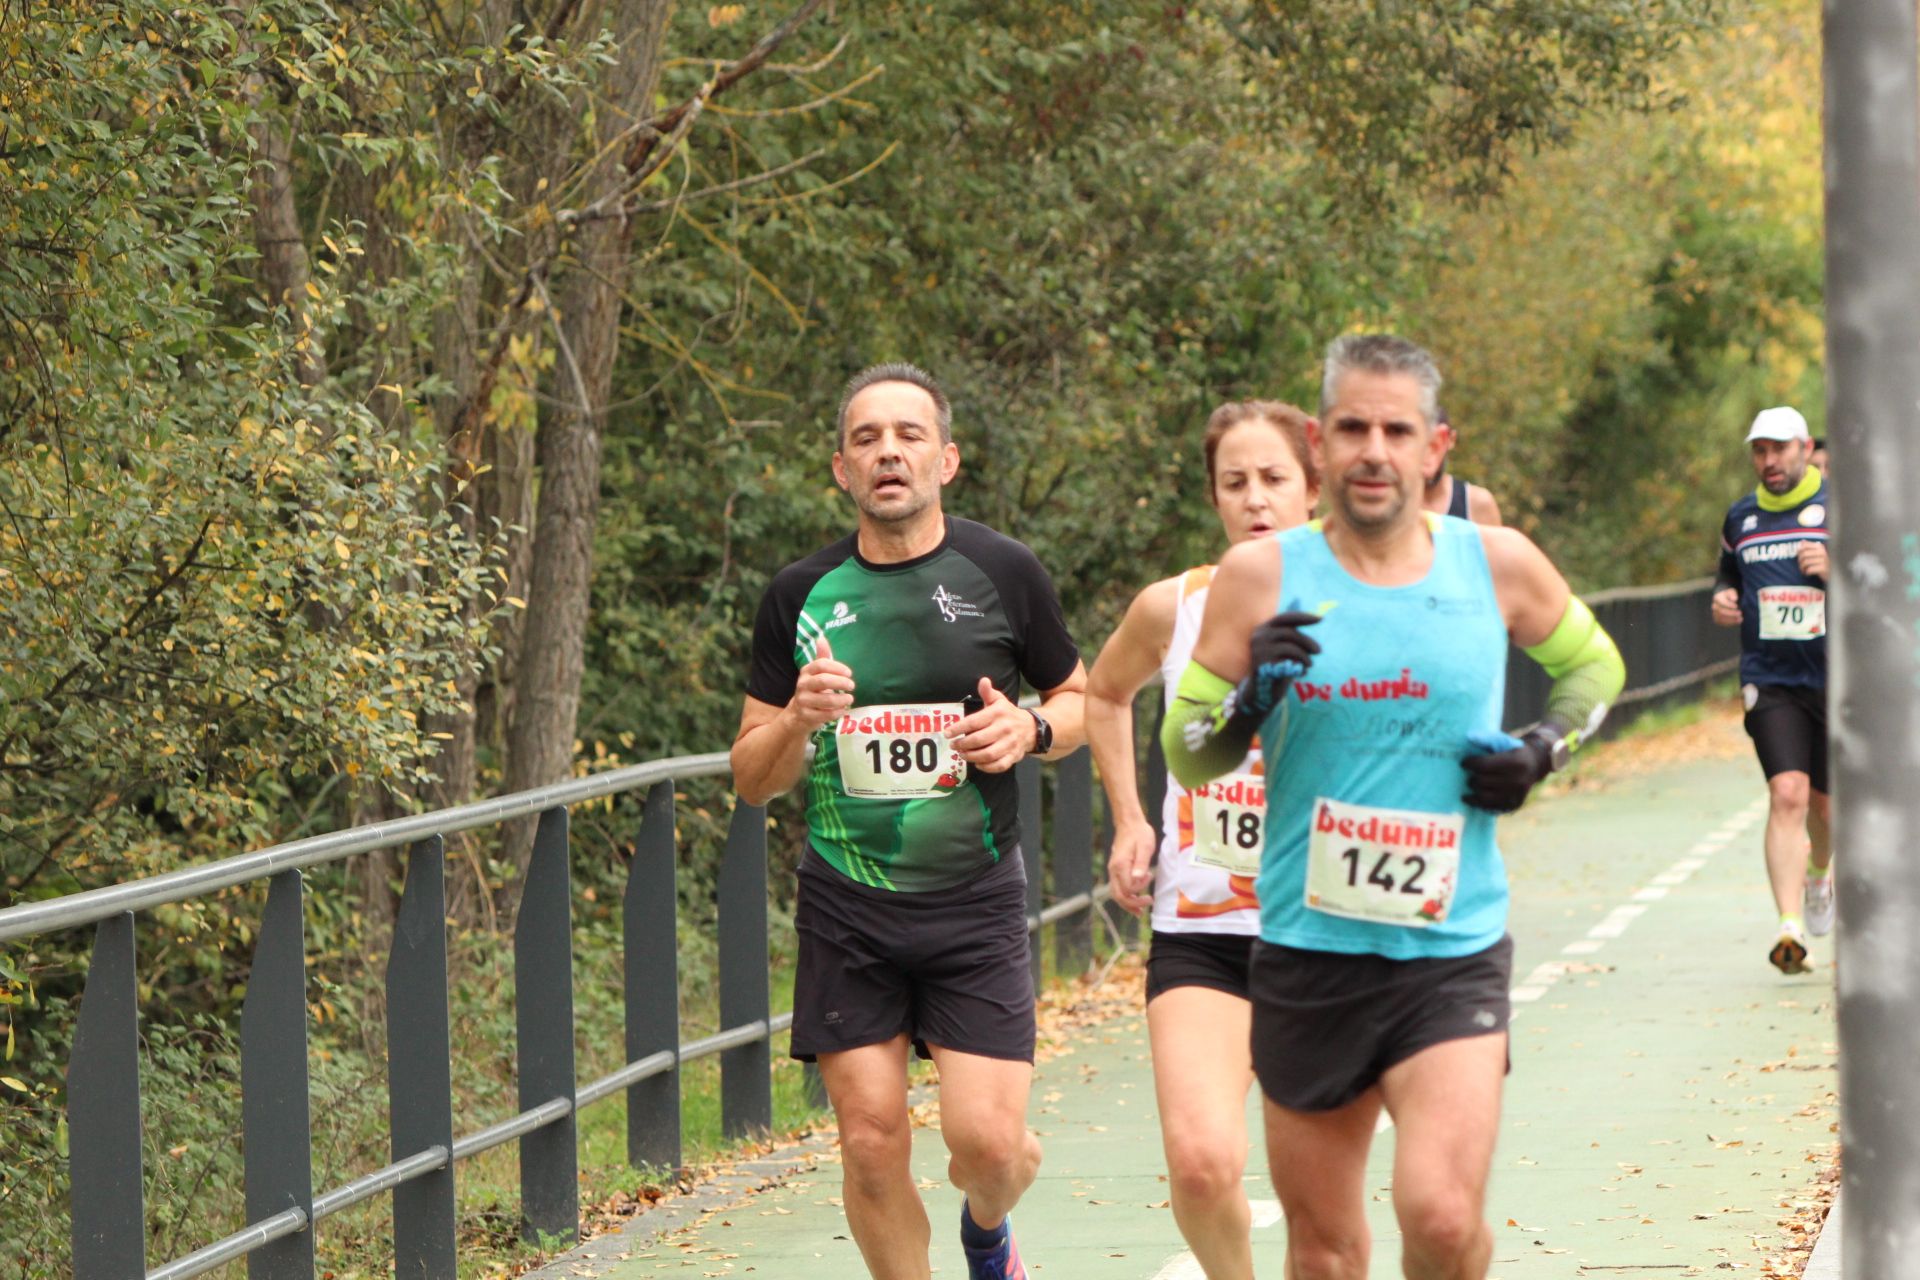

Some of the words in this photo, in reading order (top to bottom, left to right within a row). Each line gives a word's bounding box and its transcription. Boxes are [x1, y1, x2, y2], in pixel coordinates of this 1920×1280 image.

[1778, 606, 1803, 624] 70
[840, 710, 960, 735] bedunia
[866, 738, 938, 774] 180
[1316, 804, 1456, 848] bedunia
[1342, 848, 1426, 894] 142
